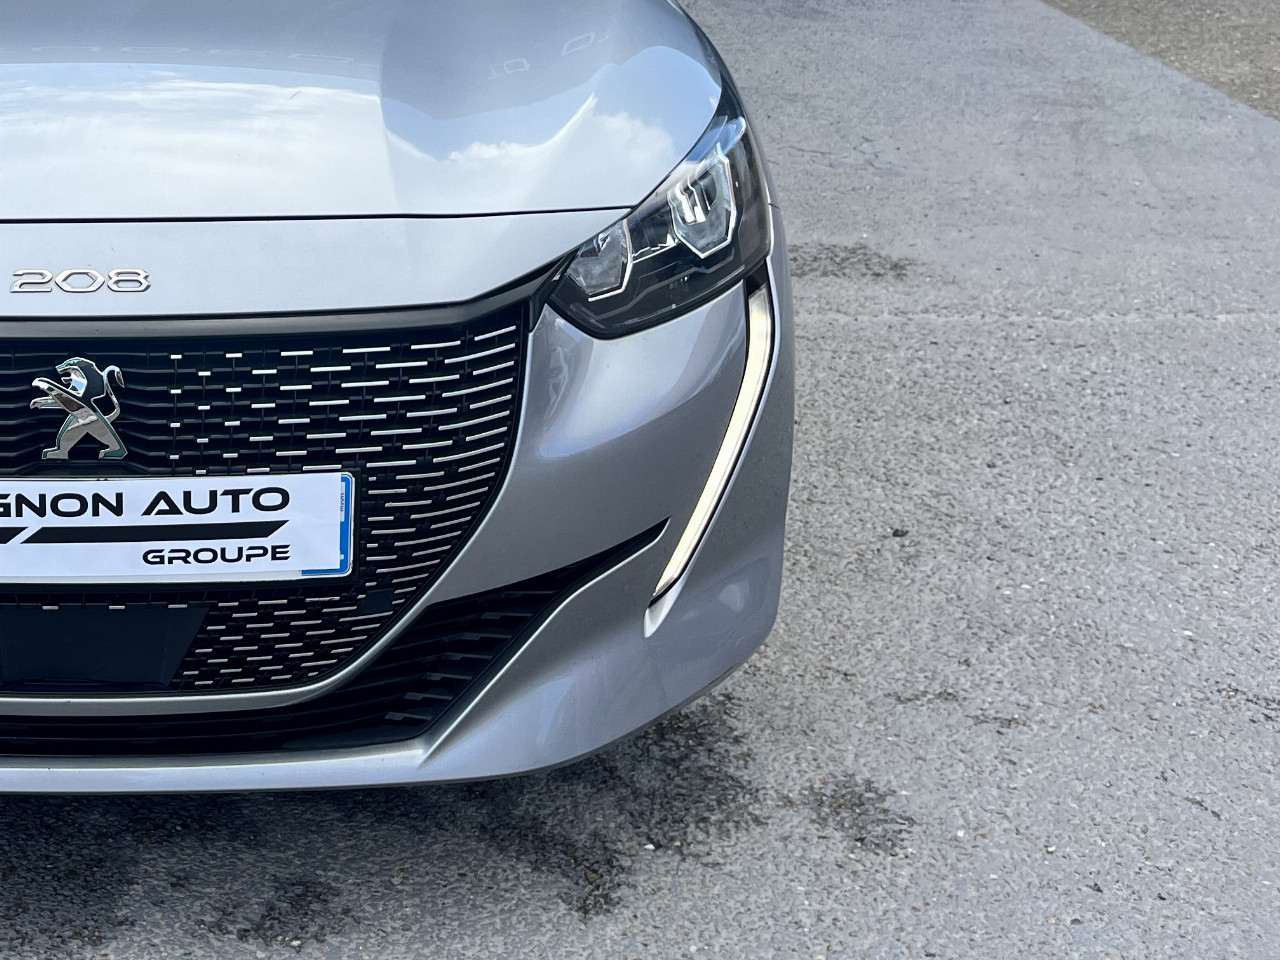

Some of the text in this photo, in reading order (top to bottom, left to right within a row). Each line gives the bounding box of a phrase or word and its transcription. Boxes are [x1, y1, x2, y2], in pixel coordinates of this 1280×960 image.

[9, 268, 152, 294] 208
[140, 486, 290, 517] AUTO
[141, 544, 291, 566] GROUPE
